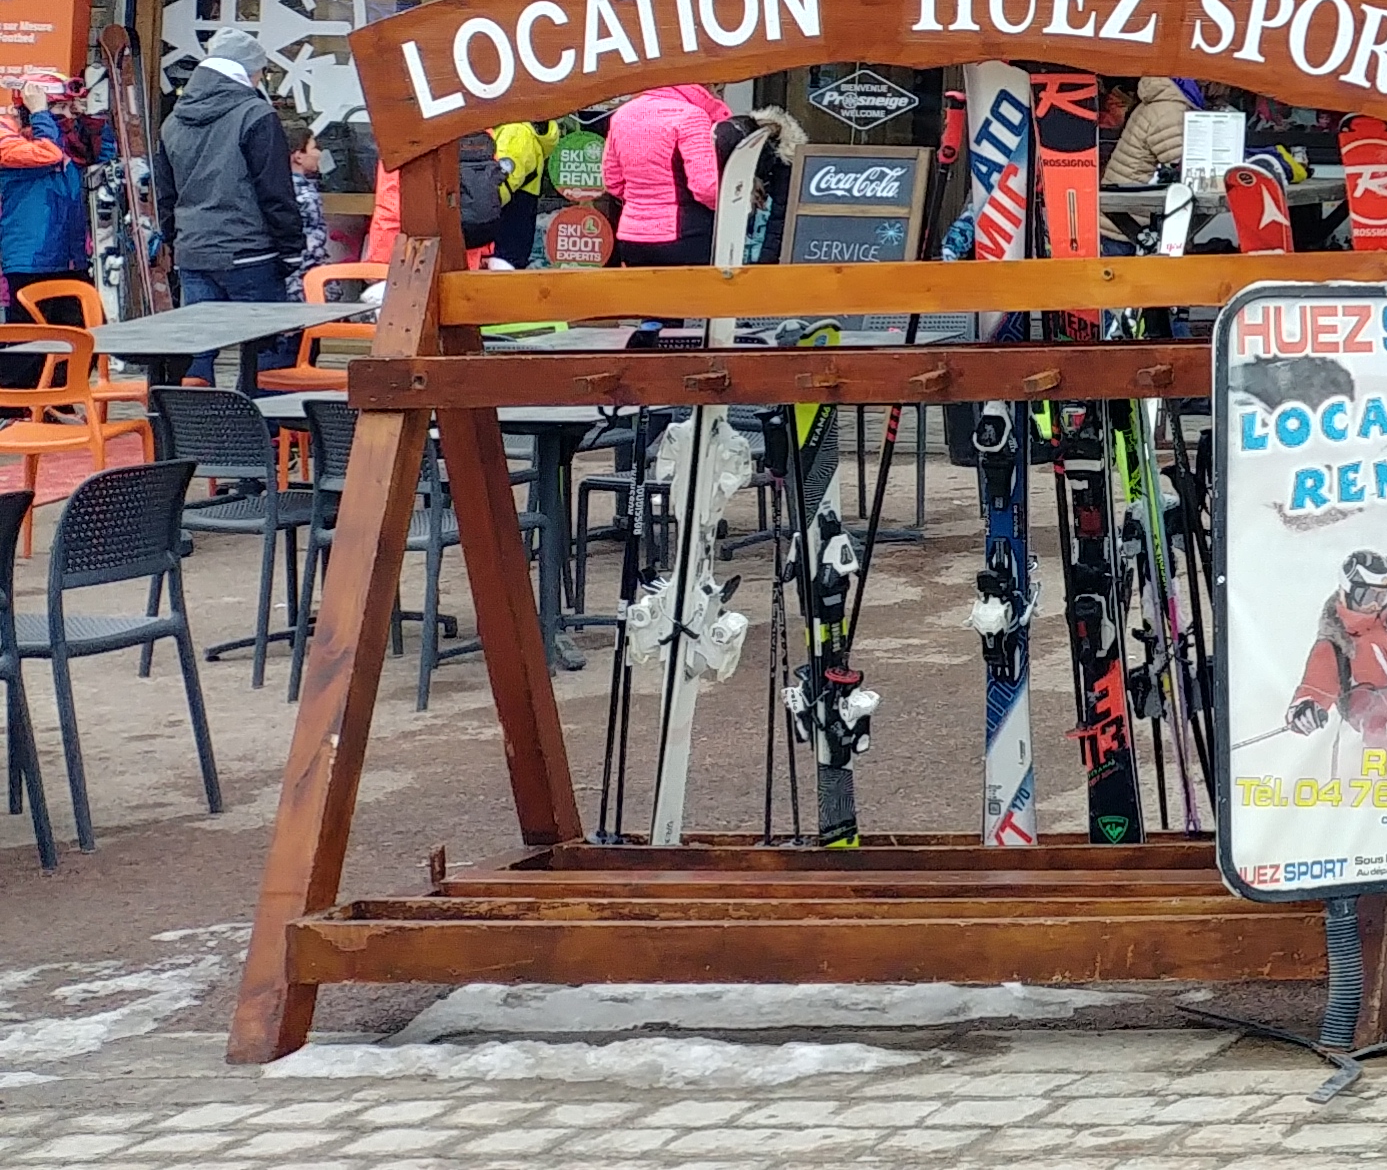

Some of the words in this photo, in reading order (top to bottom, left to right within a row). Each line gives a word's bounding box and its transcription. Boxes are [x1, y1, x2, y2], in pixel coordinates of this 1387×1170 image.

[840, 83, 889, 93] BIENVENUE
[840, 109, 886, 118] WELCOME
[560, 149, 583, 162] SKI
[560, 162, 602, 171] LOCATIO
[1043, 158, 1097, 168] ROSSIGNOL
[559, 172, 602, 186] RENT
[557, 224, 581, 236] SKI
[556, 237, 603, 251] BOOT
[556, 251, 602, 261] EXPERTS
[804, 240, 881, 263] SERVICE
[1236, 304, 1374, 355] HUEZ
[1235, 774, 1288, 807] Tél.
[1293, 778, 1343, 807] 04
[1354, 855, 1383, 866] Sous
[1284, 857, 1348, 881] SPORT
